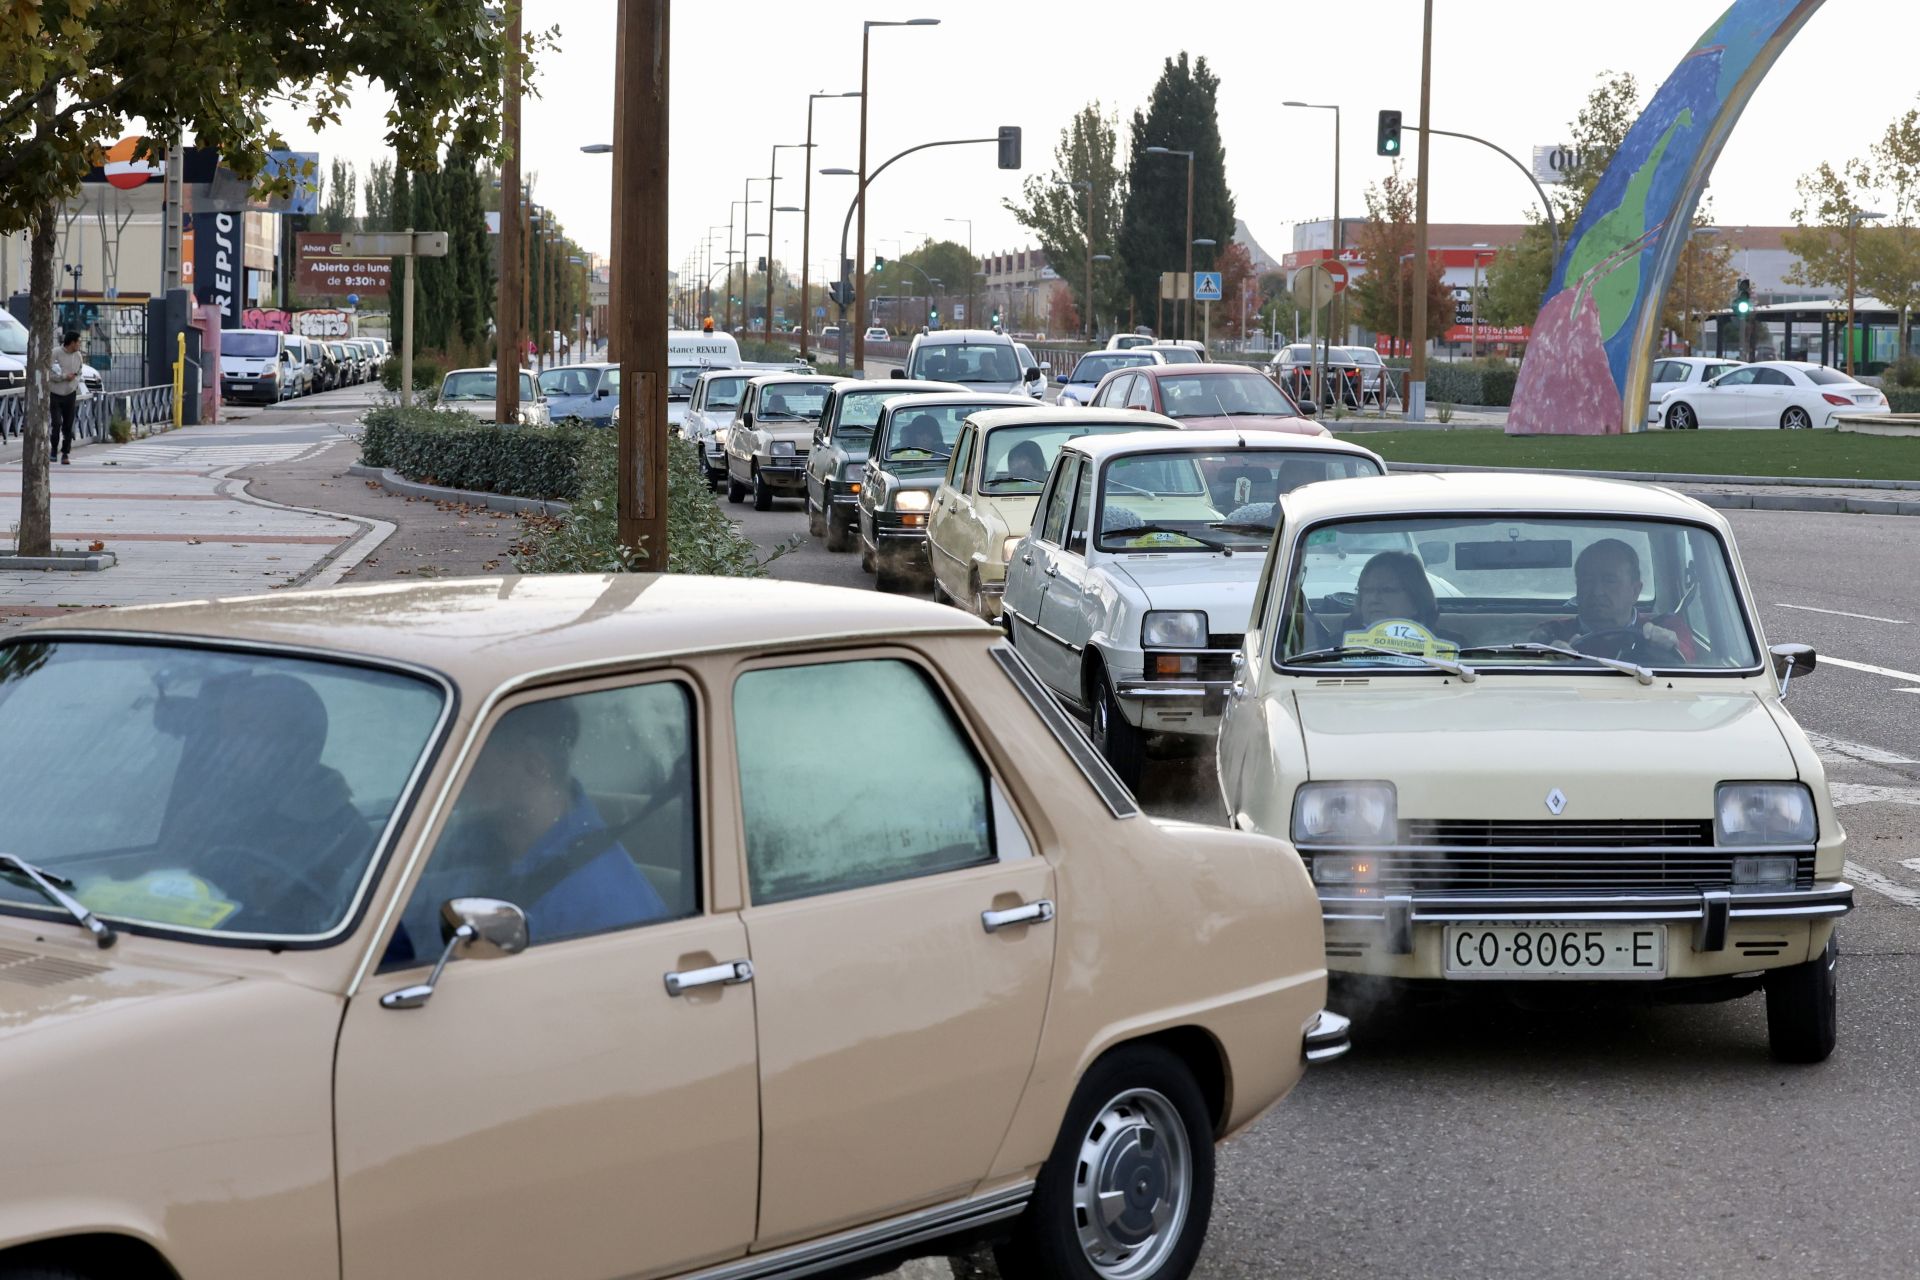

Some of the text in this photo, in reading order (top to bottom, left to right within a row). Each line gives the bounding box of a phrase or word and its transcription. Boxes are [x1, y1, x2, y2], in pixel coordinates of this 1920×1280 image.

[303, 244, 326, 252] Ahora
[310, 262, 391, 272] Abierto de lune
[327, 276, 341, 286] de
[345, 276, 376, 286] 9:30h
[696, 345, 727, 354] RENAULT
[1393, 625, 1410, 638] 17
